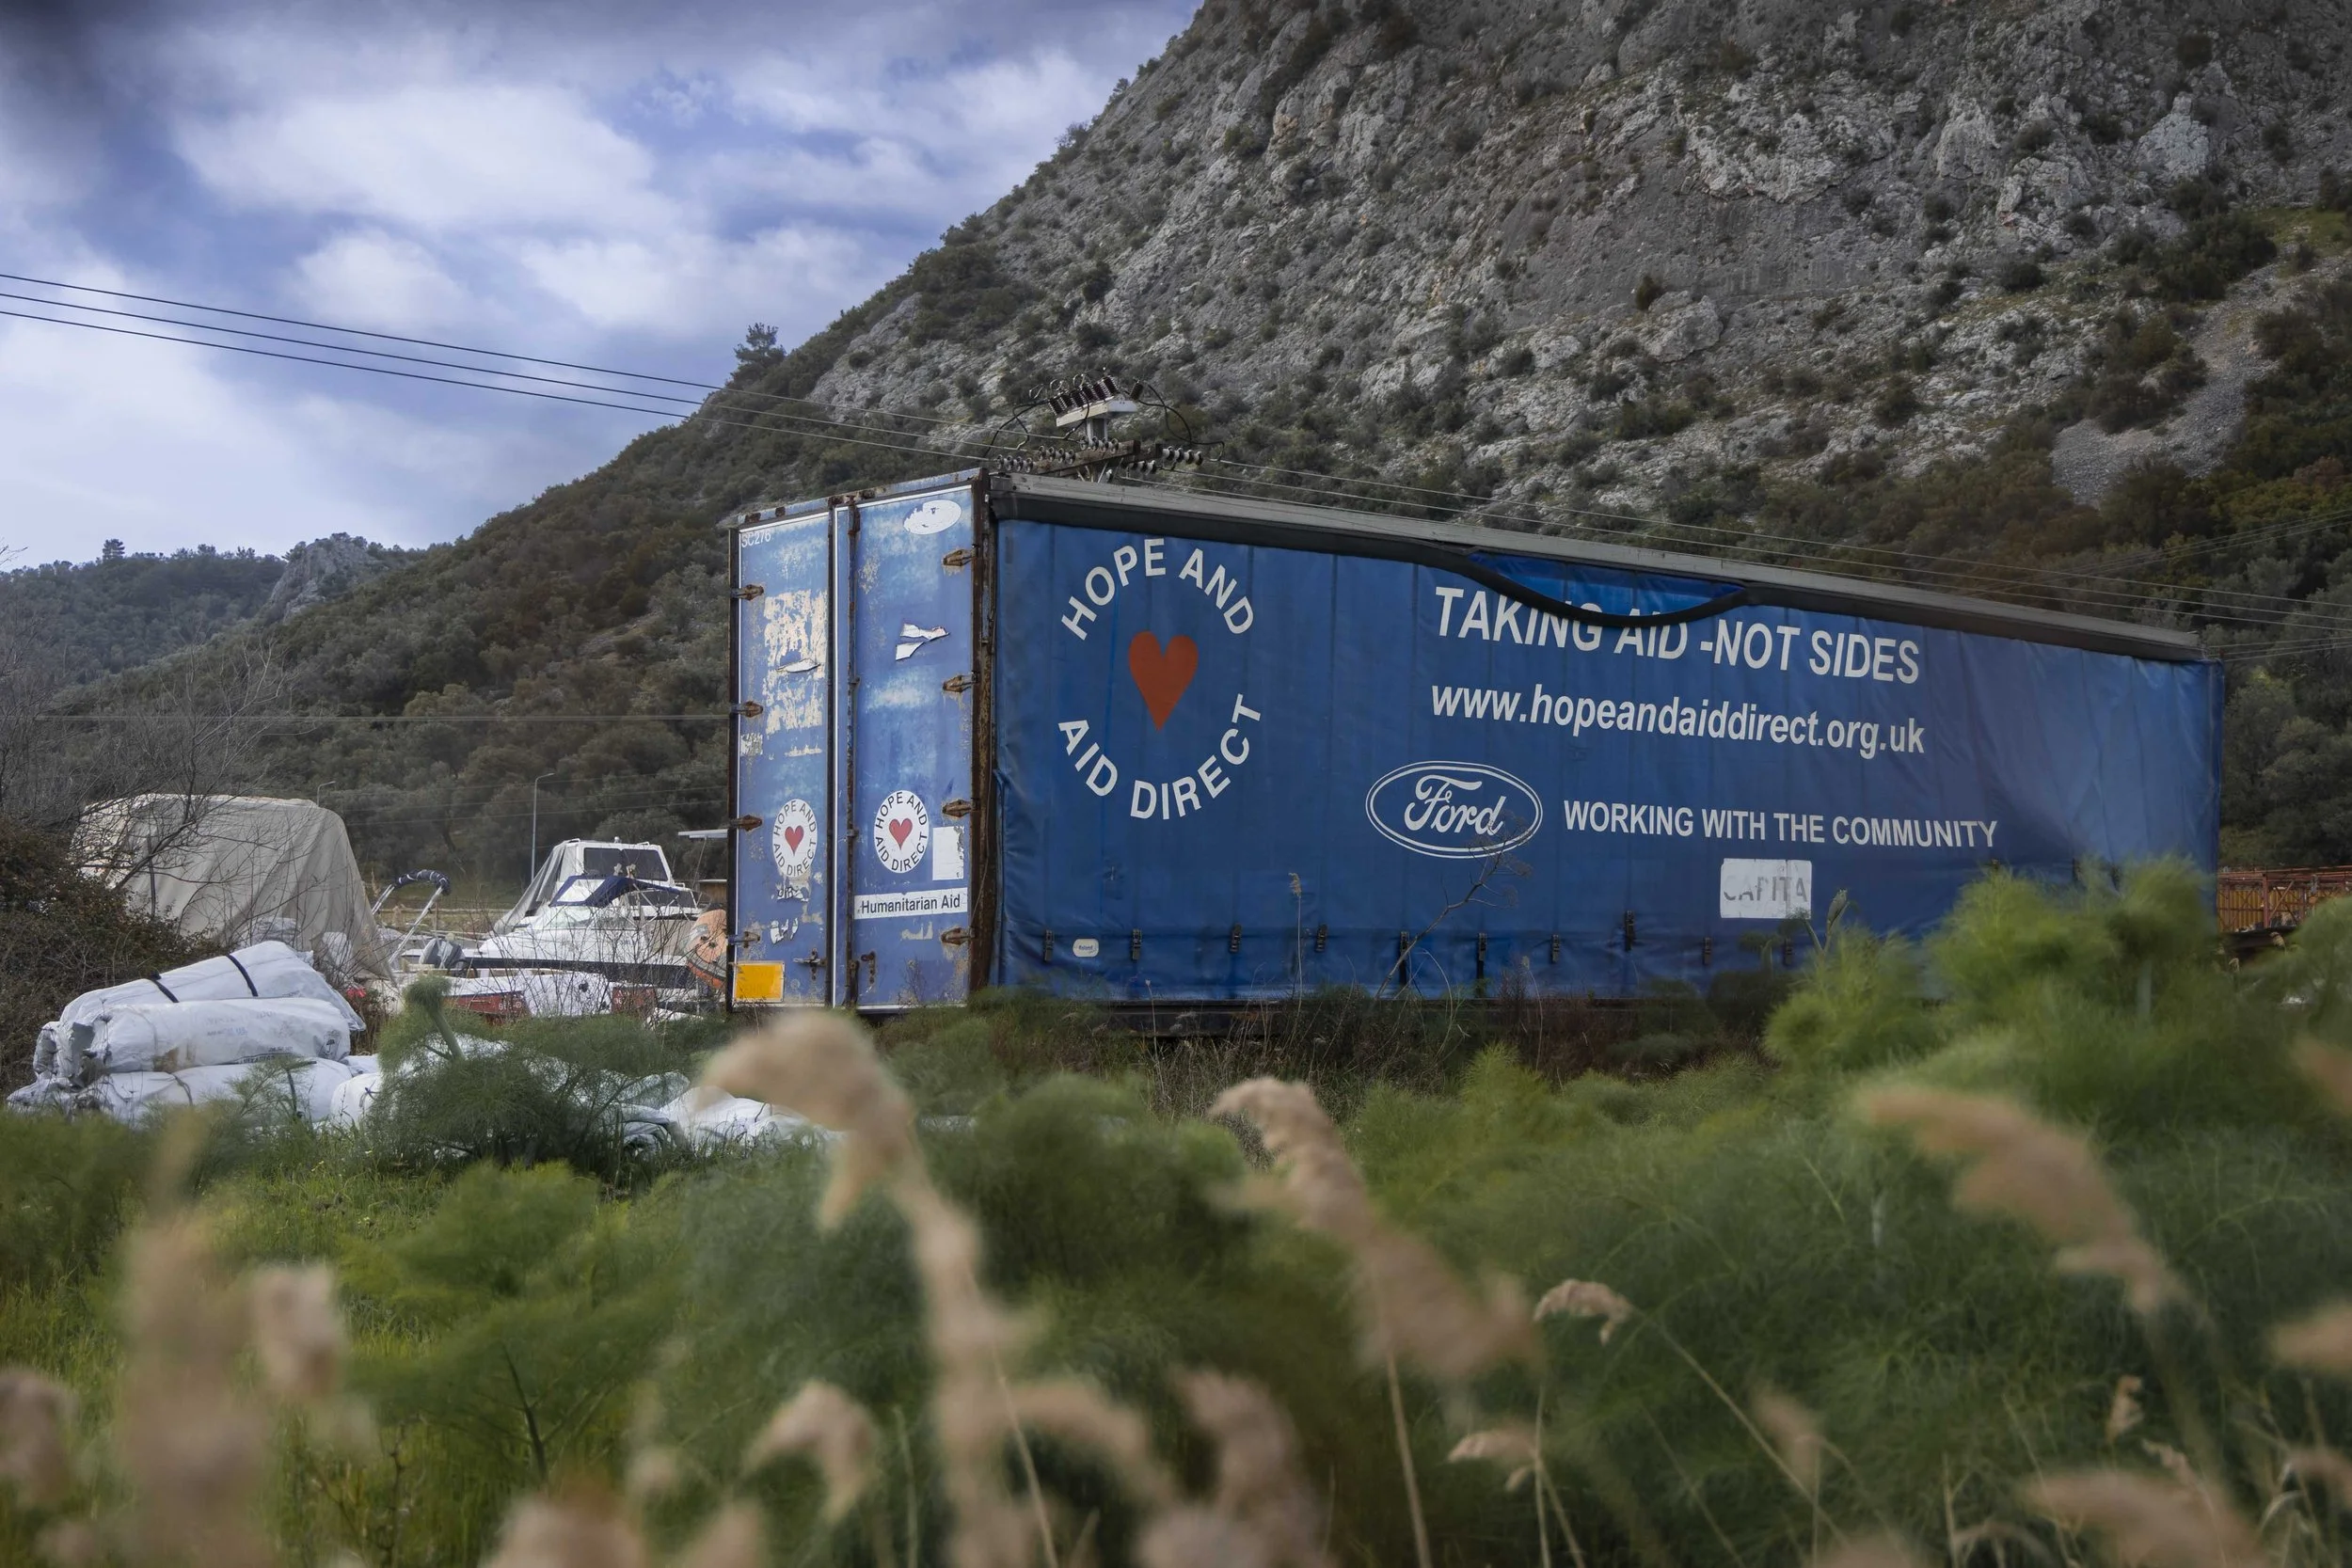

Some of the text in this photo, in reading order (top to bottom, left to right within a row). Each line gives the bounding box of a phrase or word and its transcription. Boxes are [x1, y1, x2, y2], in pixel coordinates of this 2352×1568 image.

[1060, 537, 1254, 641] HOPE AND
[1435, 586, 1603, 651] TAKING
[1613, 608, 1689, 659] AID
[1809, 630, 1920, 684] SIDES
[1431, 683, 1926, 760] www.hopeandaiddirect.org.uk
[1057, 692, 1262, 820] AID DIRECT
[773, 800, 817, 836] HOPE AND
[875, 791, 928, 829] HOPE AND
[1404, 774, 1507, 836] Ford
[1563, 800, 1998, 847] WORKING WITH THE COMMUNITY
[773, 838, 817, 877] AID DIRECT
[875, 832, 928, 872] AID DIRECT
[861, 894, 961, 914] Humanitarian Aid
